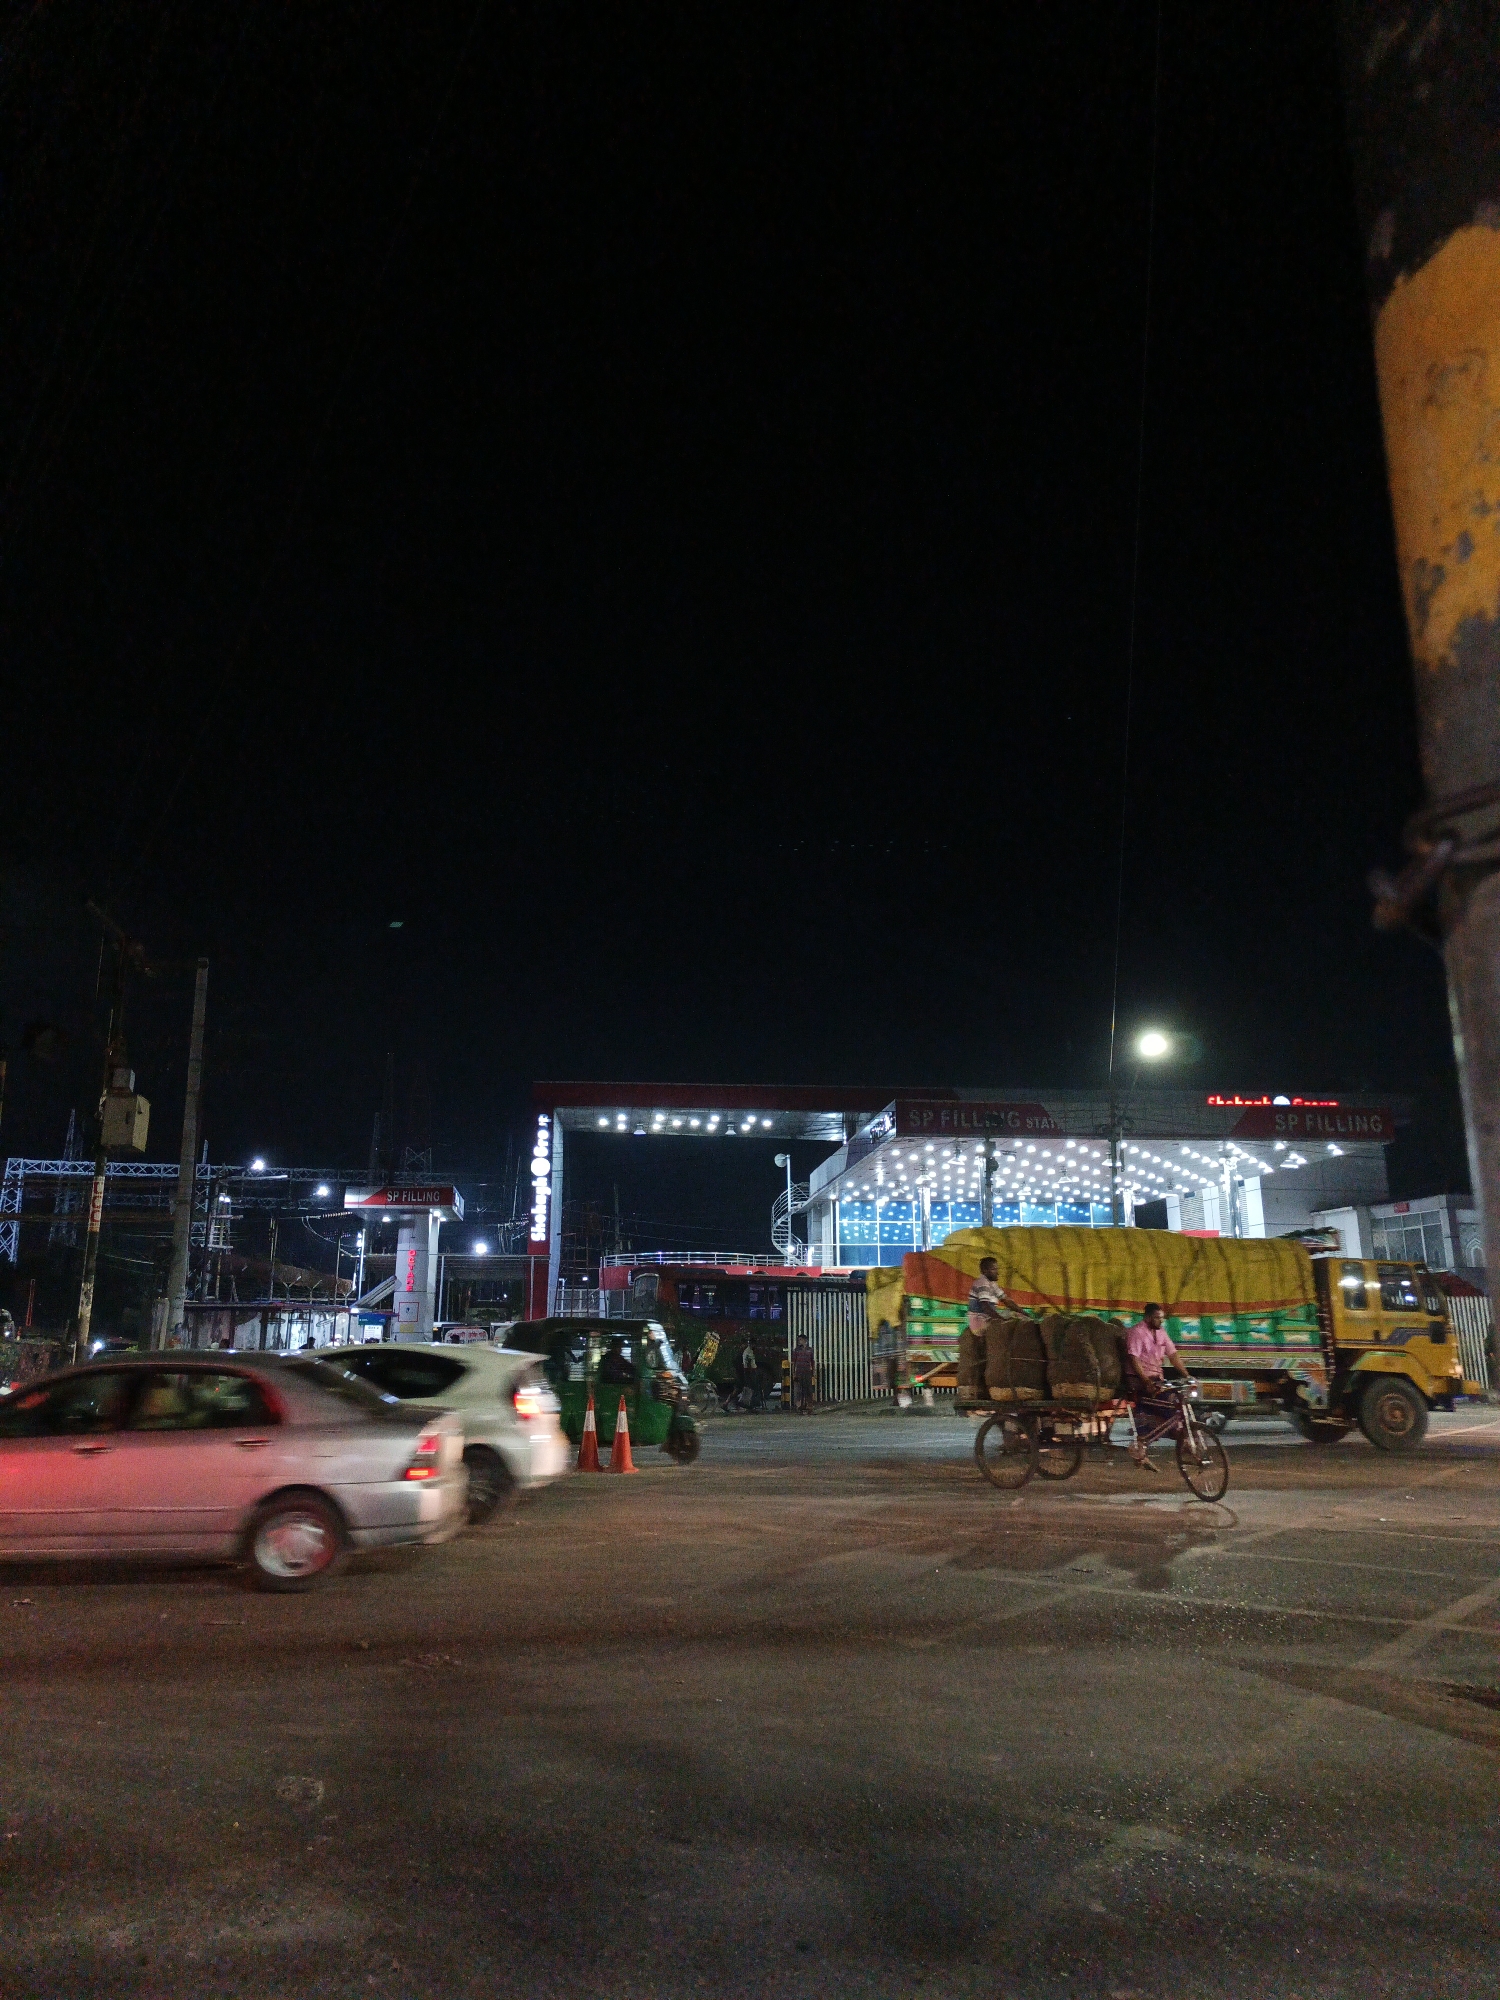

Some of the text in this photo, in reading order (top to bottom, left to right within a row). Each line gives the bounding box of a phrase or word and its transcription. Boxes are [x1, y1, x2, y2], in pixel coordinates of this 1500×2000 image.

[909, 1109, 934, 1128] SP
[1275, 1113, 1383, 1133] SP FILLING
[387, 1190, 440, 1202] SP FILLING
